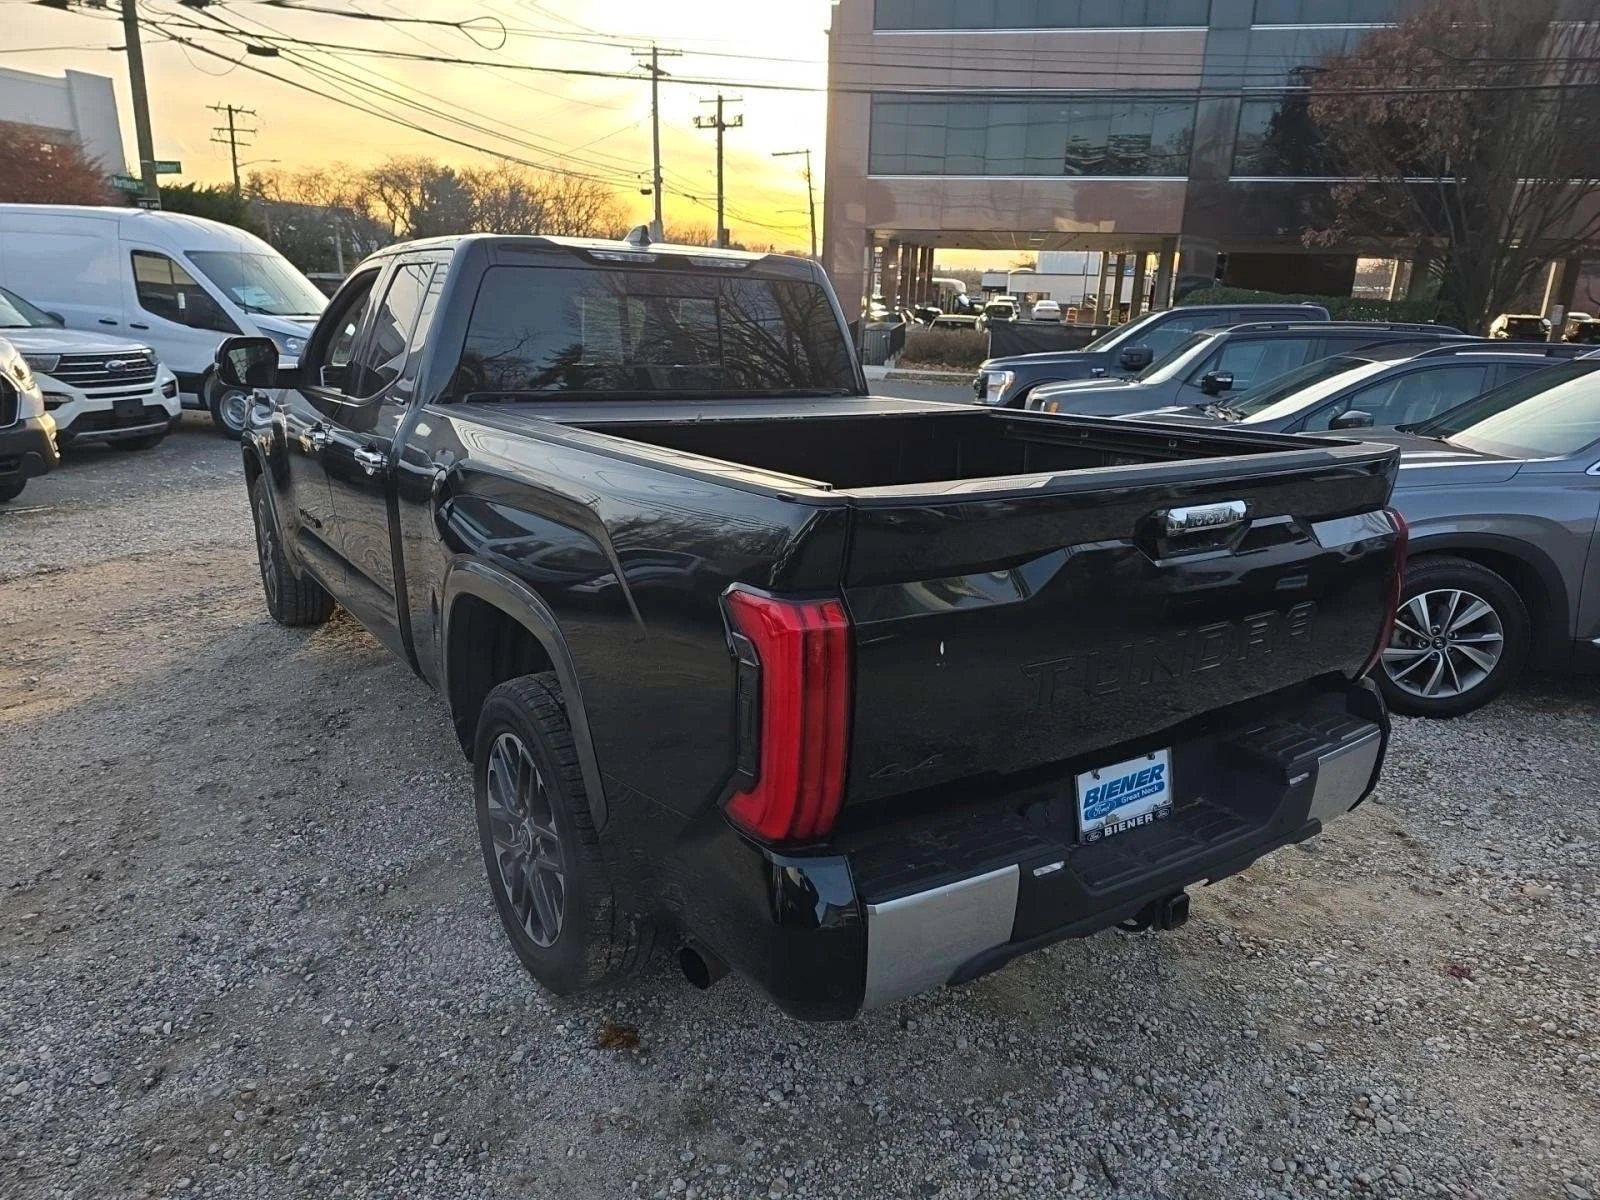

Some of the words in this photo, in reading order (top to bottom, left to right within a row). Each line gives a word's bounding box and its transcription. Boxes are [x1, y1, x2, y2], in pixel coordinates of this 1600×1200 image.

[1020, 600, 1319, 703] TUNDRA
[1083, 763, 1165, 809] BIENER
[1121, 793, 1141, 803] Great
[1140, 785, 1159, 798] Neck
[1104, 813, 1154, 837] BIENER
